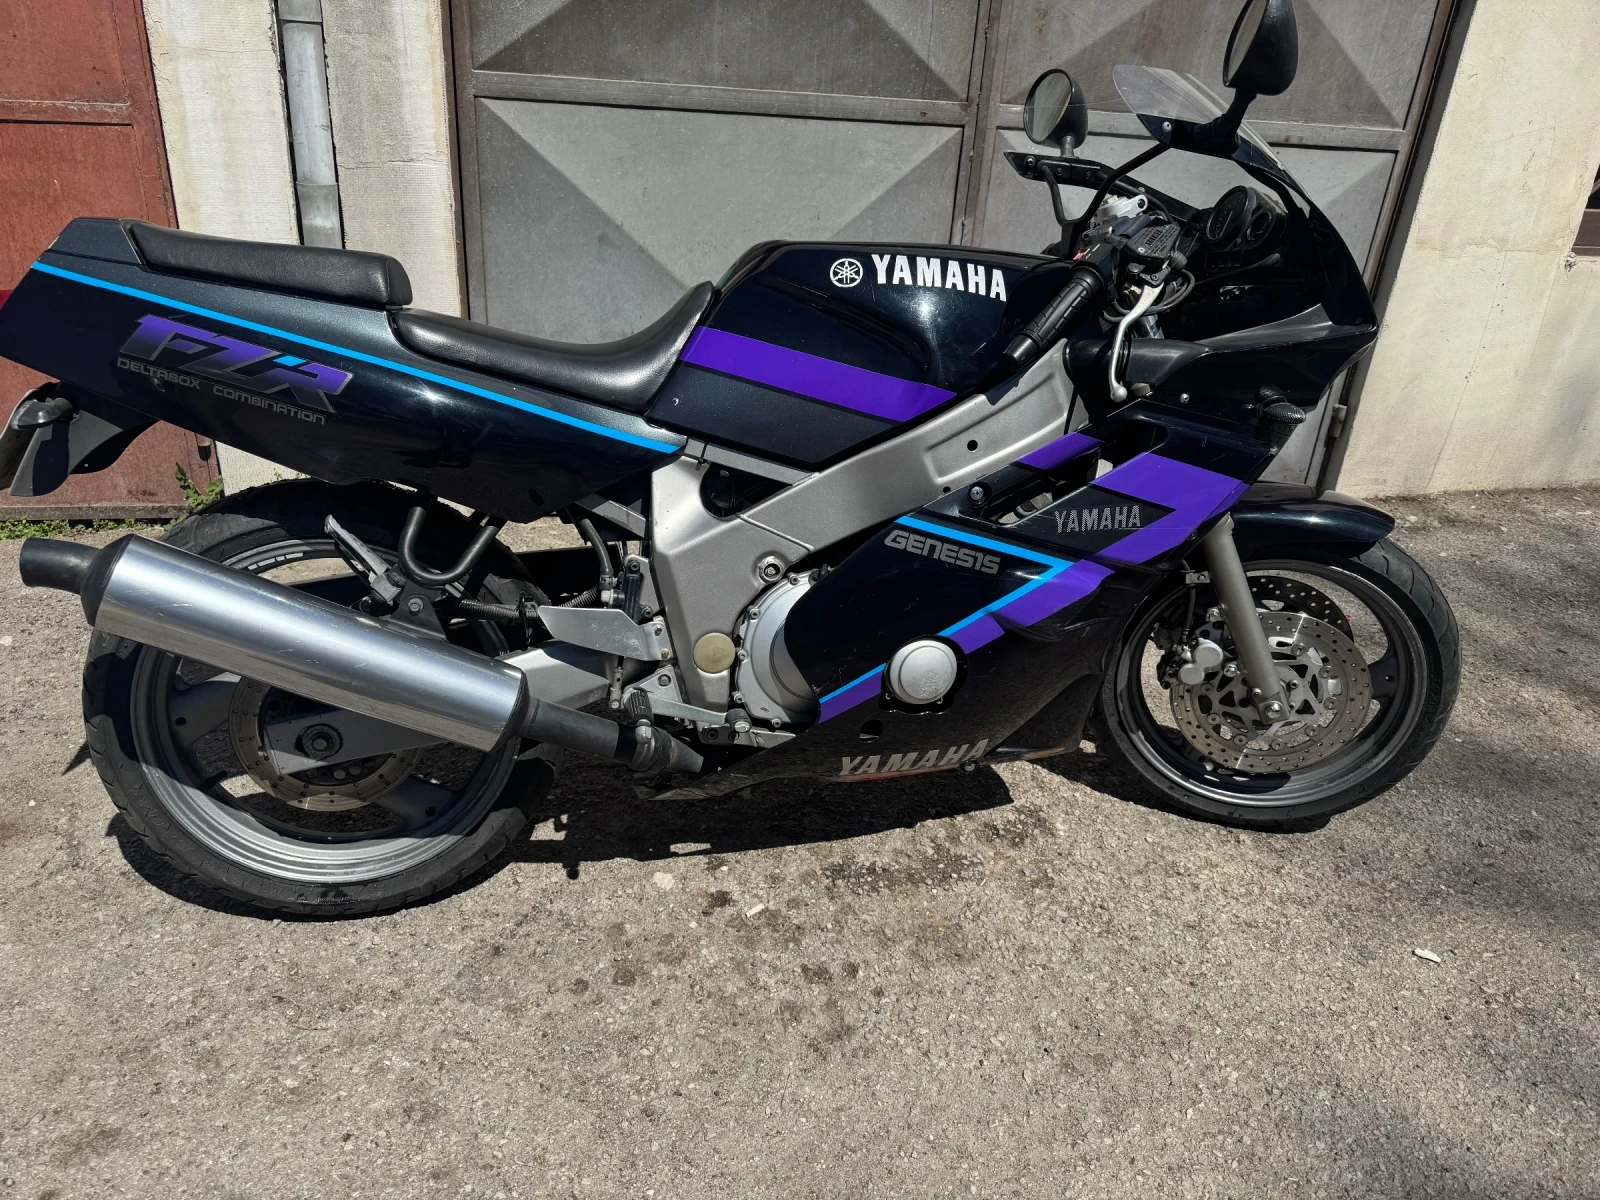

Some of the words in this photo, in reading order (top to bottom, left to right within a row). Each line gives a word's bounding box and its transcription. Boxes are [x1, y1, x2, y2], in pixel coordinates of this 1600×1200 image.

[871, 254, 1007, 302] YAMAHA
[120, 314, 354, 414] FZR
[116, 356, 201, 391] DELTABOX
[213, 385, 326, 425] COMBINATION
[1054, 504, 1142, 534] YAMAHA
[884, 528, 1001, 575] GENESIS
[839, 738, 989, 776] YAMAHA
